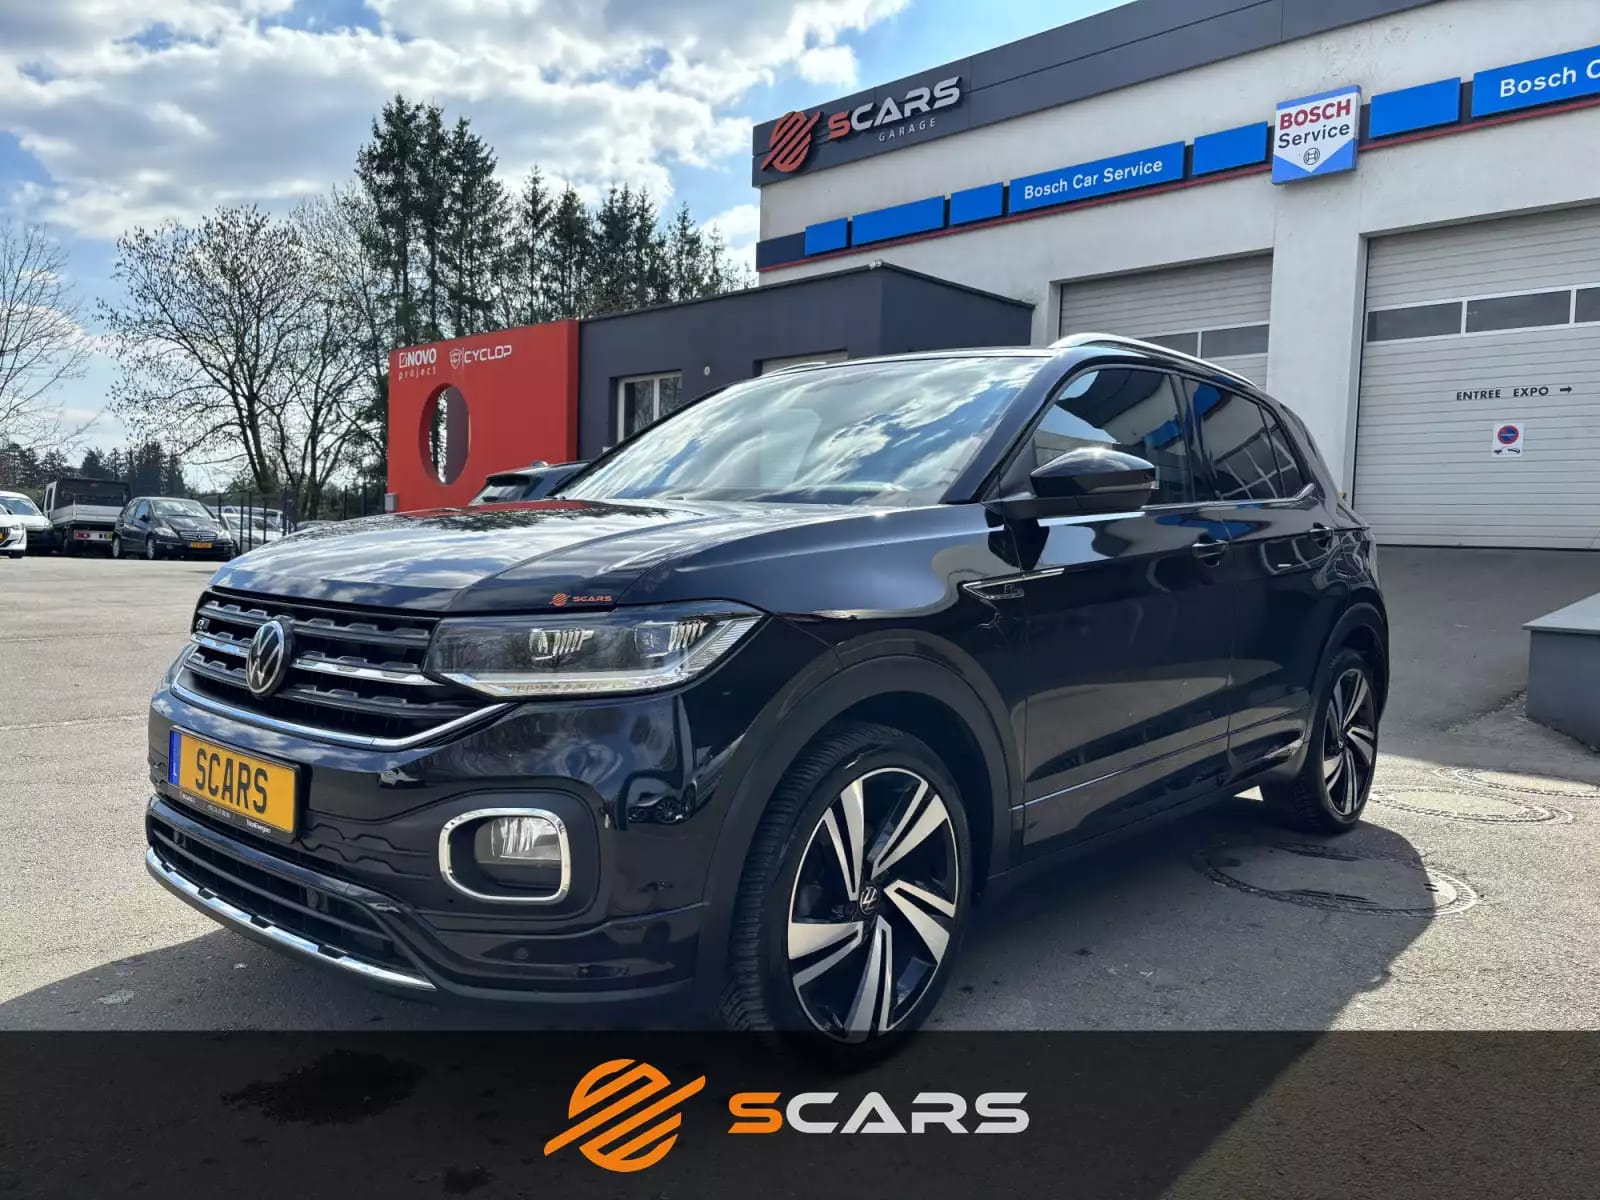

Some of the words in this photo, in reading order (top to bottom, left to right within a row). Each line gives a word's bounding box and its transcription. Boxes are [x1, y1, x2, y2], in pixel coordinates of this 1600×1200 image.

[1500, 66, 1577, 98] Bosch
[828, 76, 962, 140] SCARS
[1280, 98, 1351, 131] BOSCH
[878, 117, 937, 142] GARAGE
[1277, 121, 1350, 149] Service
[1024, 178, 1068, 199] Bosch
[1072, 172, 1099, 189] Car
[1103, 160, 1163, 183] Service
[464, 345, 512, 364] CYCLOP
[398, 366, 436, 381] project
[1456, 389, 1501, 400] ENTREE
[1513, 386, 1549, 397] EXPO
[195, 748, 268, 814] SCARS
